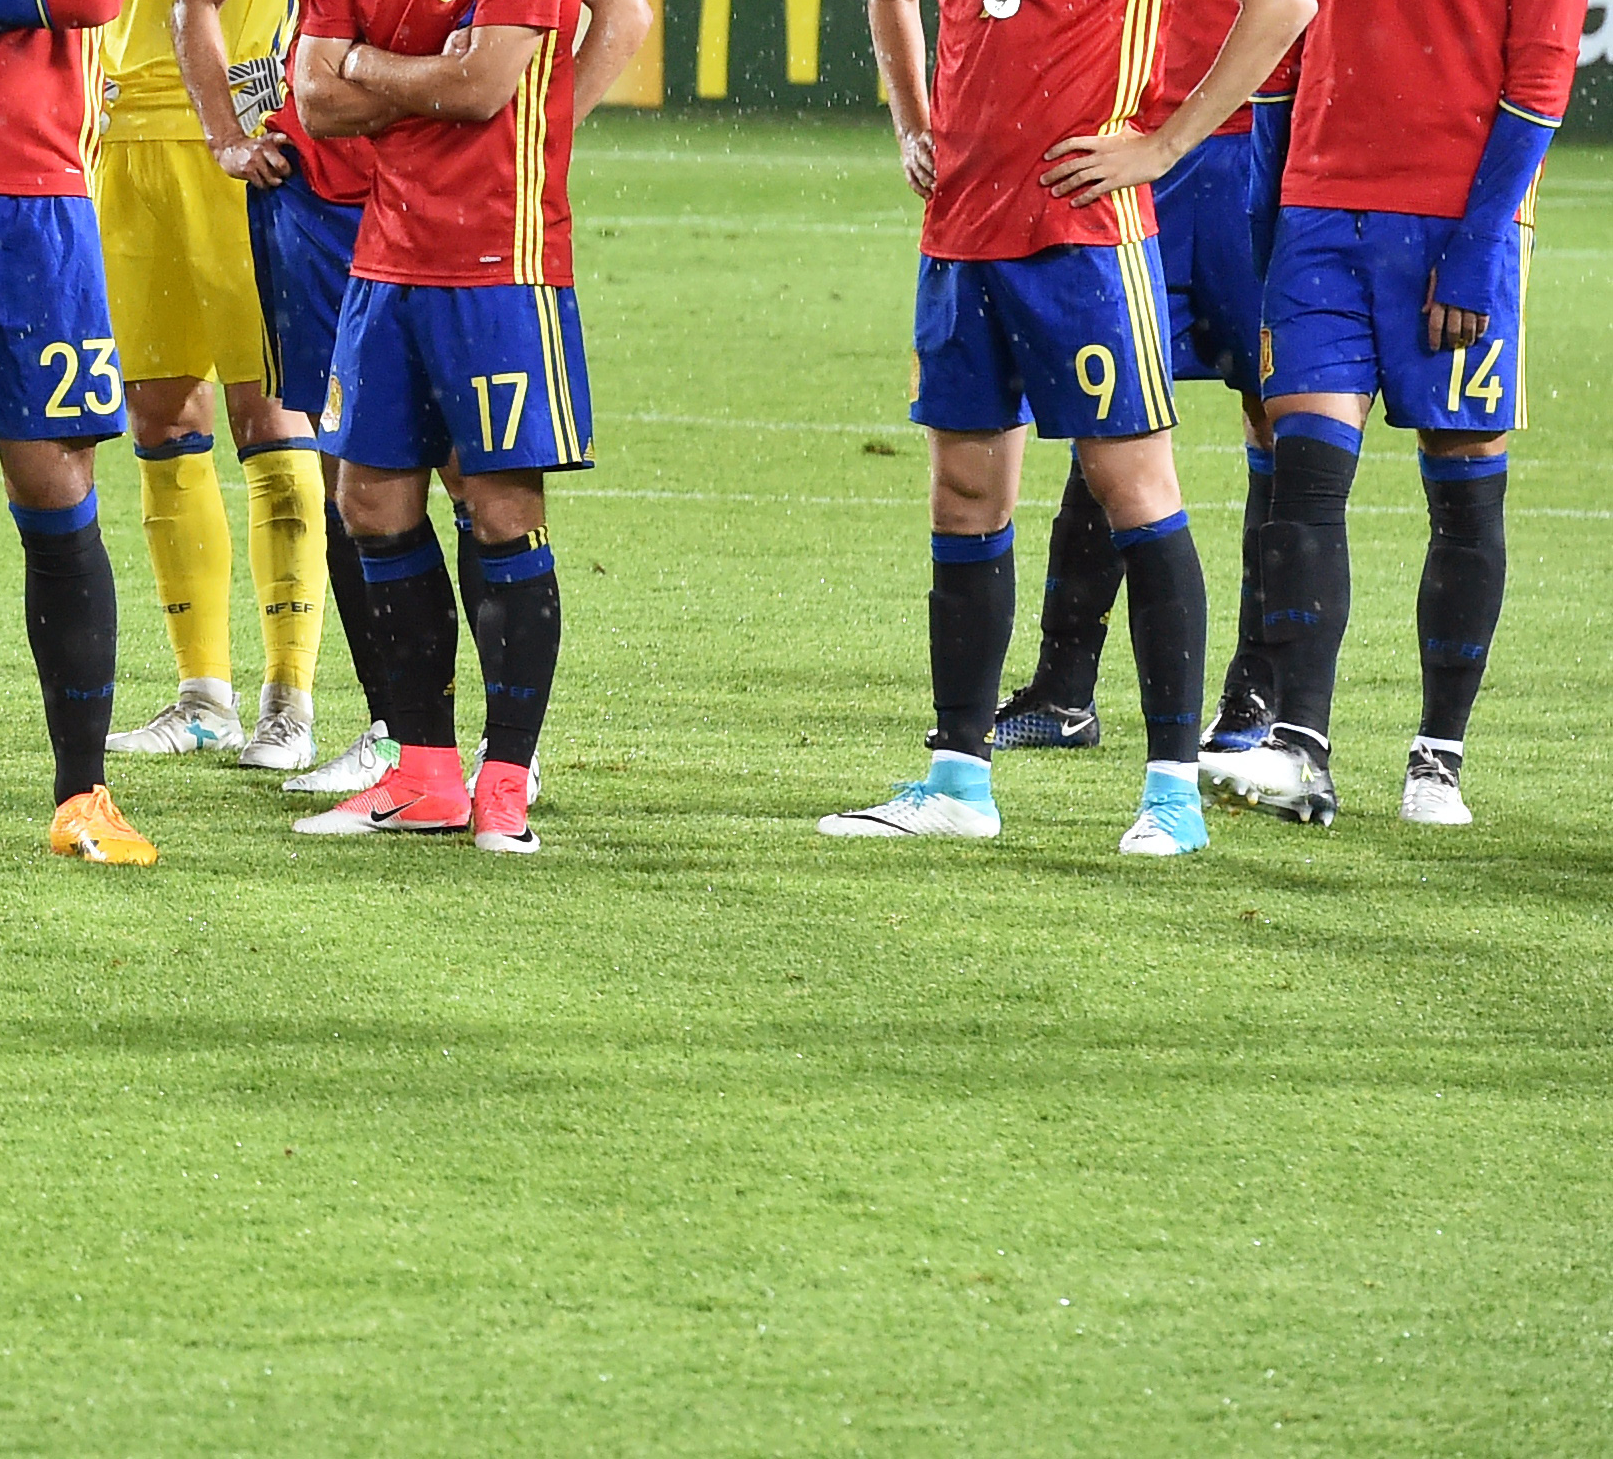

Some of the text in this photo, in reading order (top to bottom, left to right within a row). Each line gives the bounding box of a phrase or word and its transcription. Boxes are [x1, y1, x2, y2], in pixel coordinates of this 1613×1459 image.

[39, 337, 123, 418] 23
[471, 371, 528, 453] 17
[1075, 344, 1117, 420] 9
[1447, 339, 1505, 414] 14
[265, 601, 315, 616] RFEF
